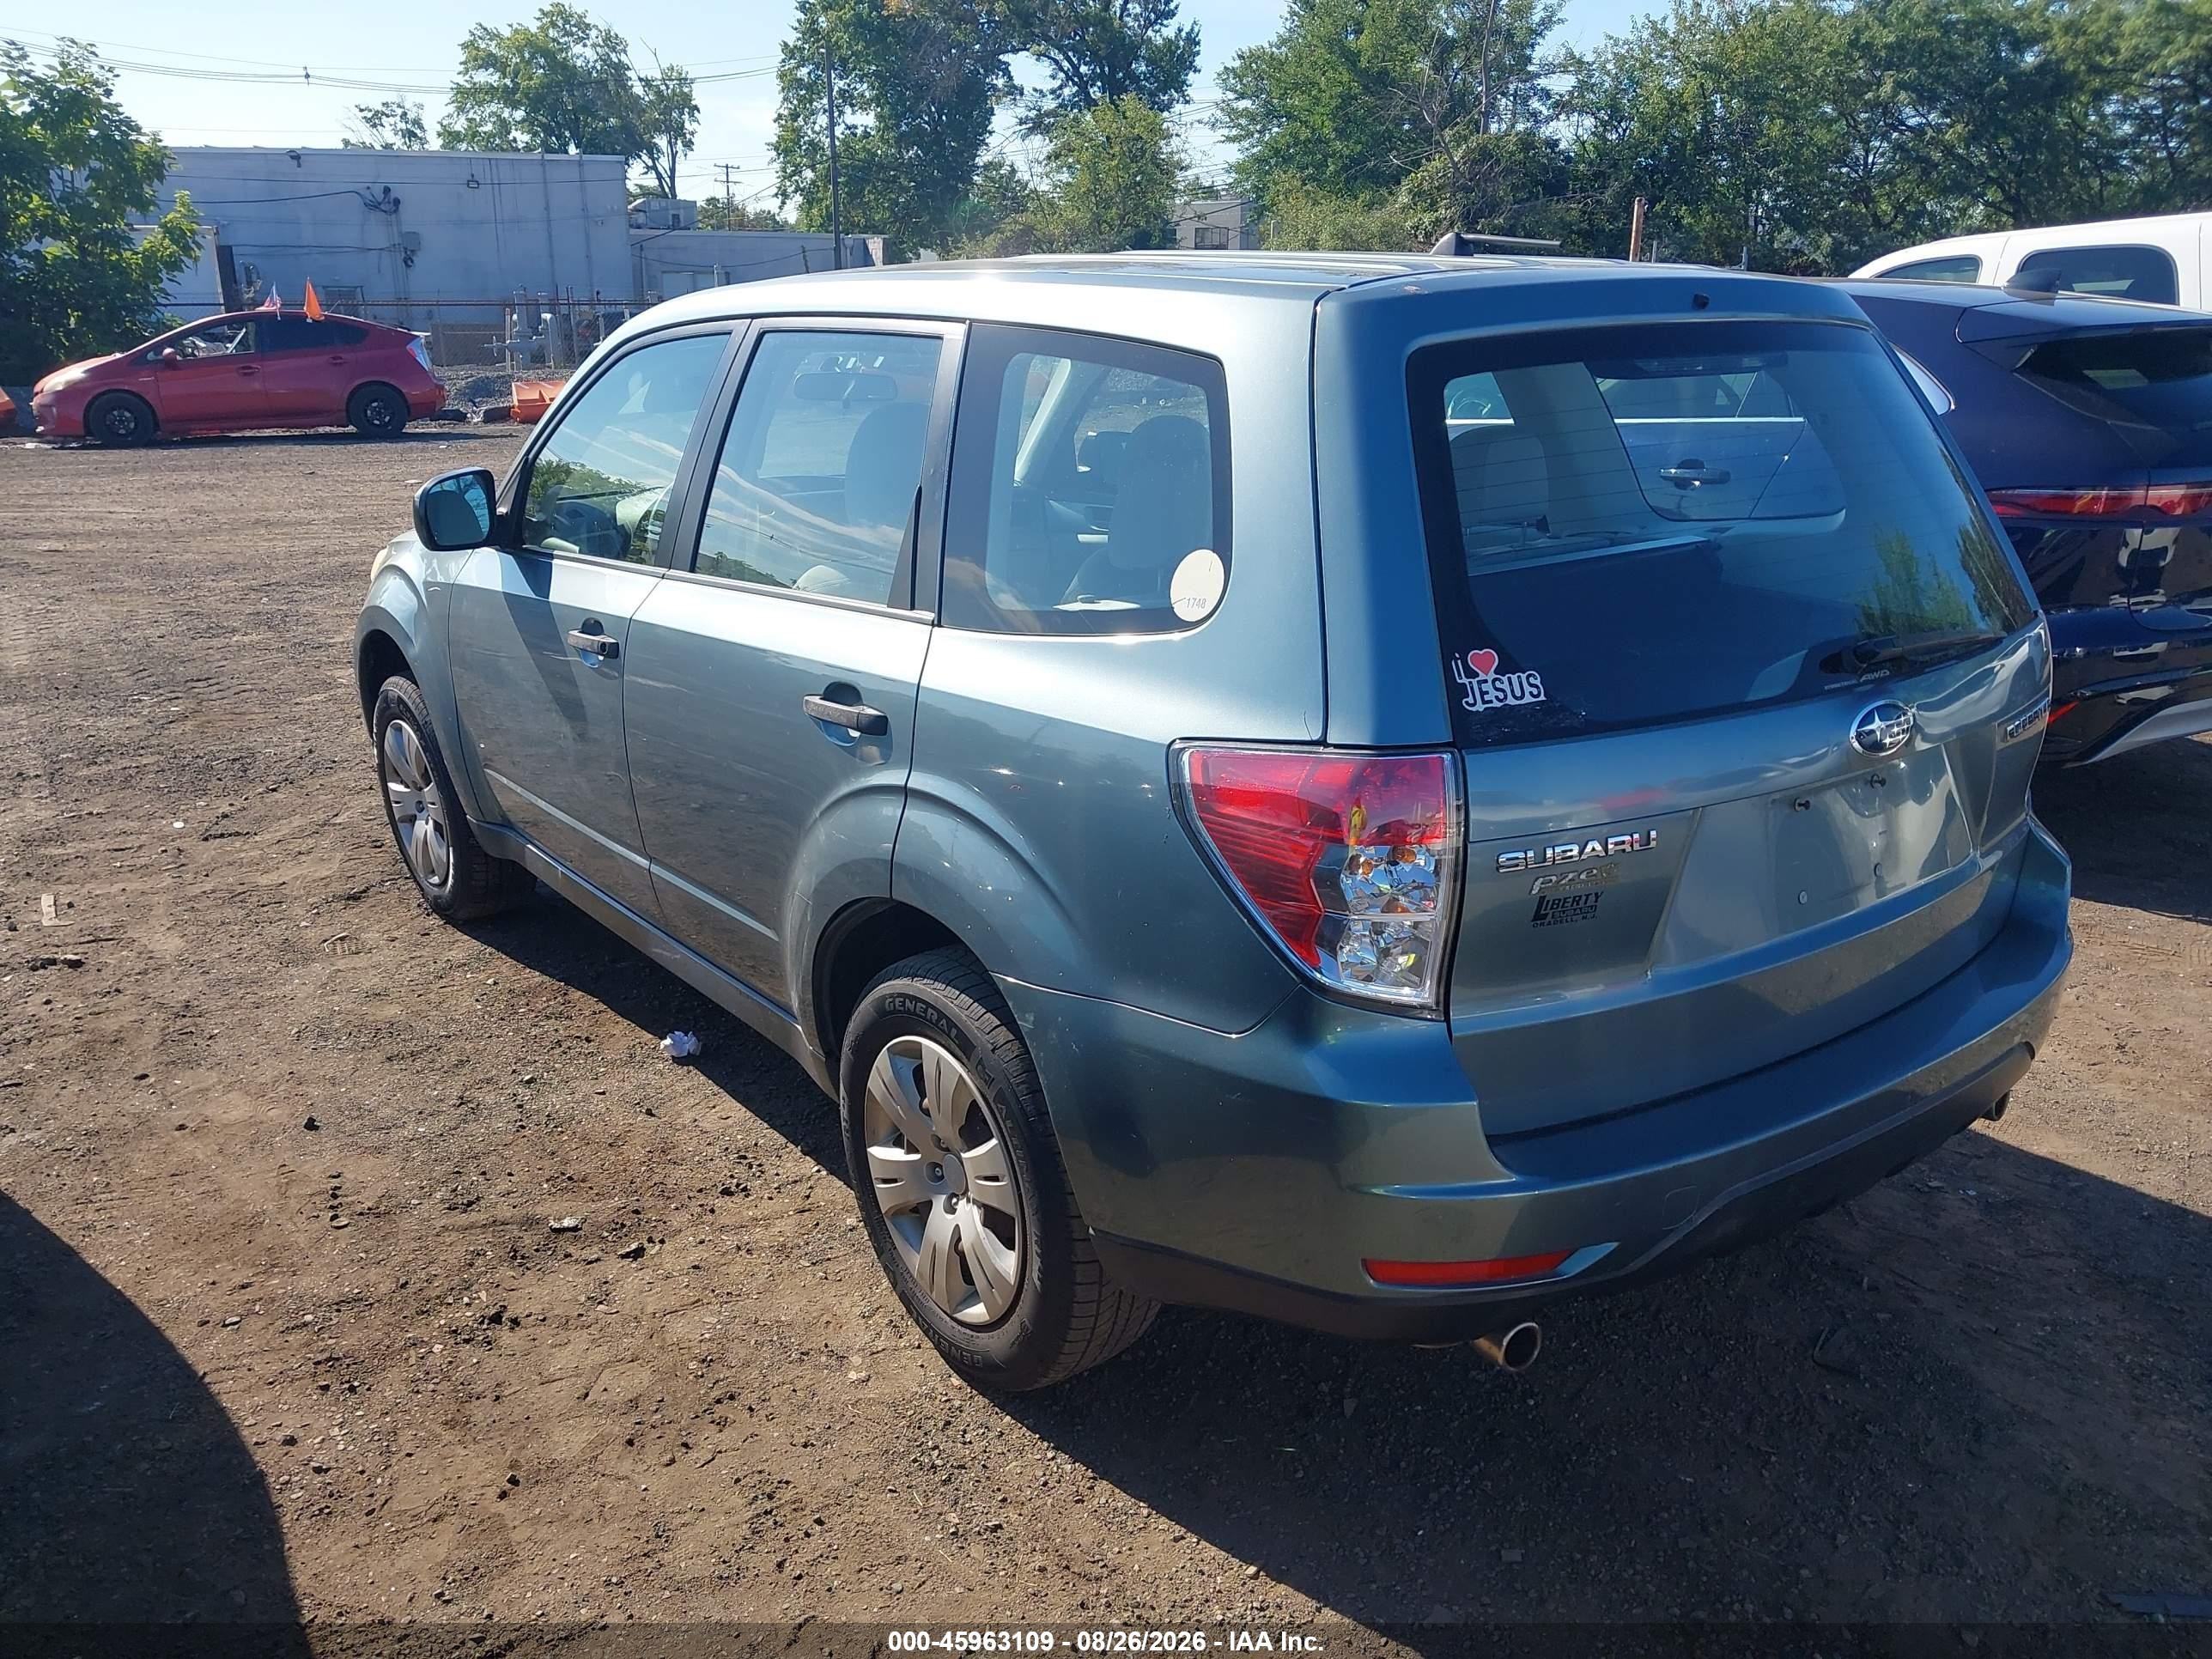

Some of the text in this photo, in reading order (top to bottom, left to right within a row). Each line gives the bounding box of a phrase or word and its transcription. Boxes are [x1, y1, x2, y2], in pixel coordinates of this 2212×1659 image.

[1463, 673, 1542, 708] JESUS
[1497, 830, 1656, 872] SUBARU
[1530, 891, 1604, 922] LIBERTY
[885, 997, 962, 1046] GENERAL
